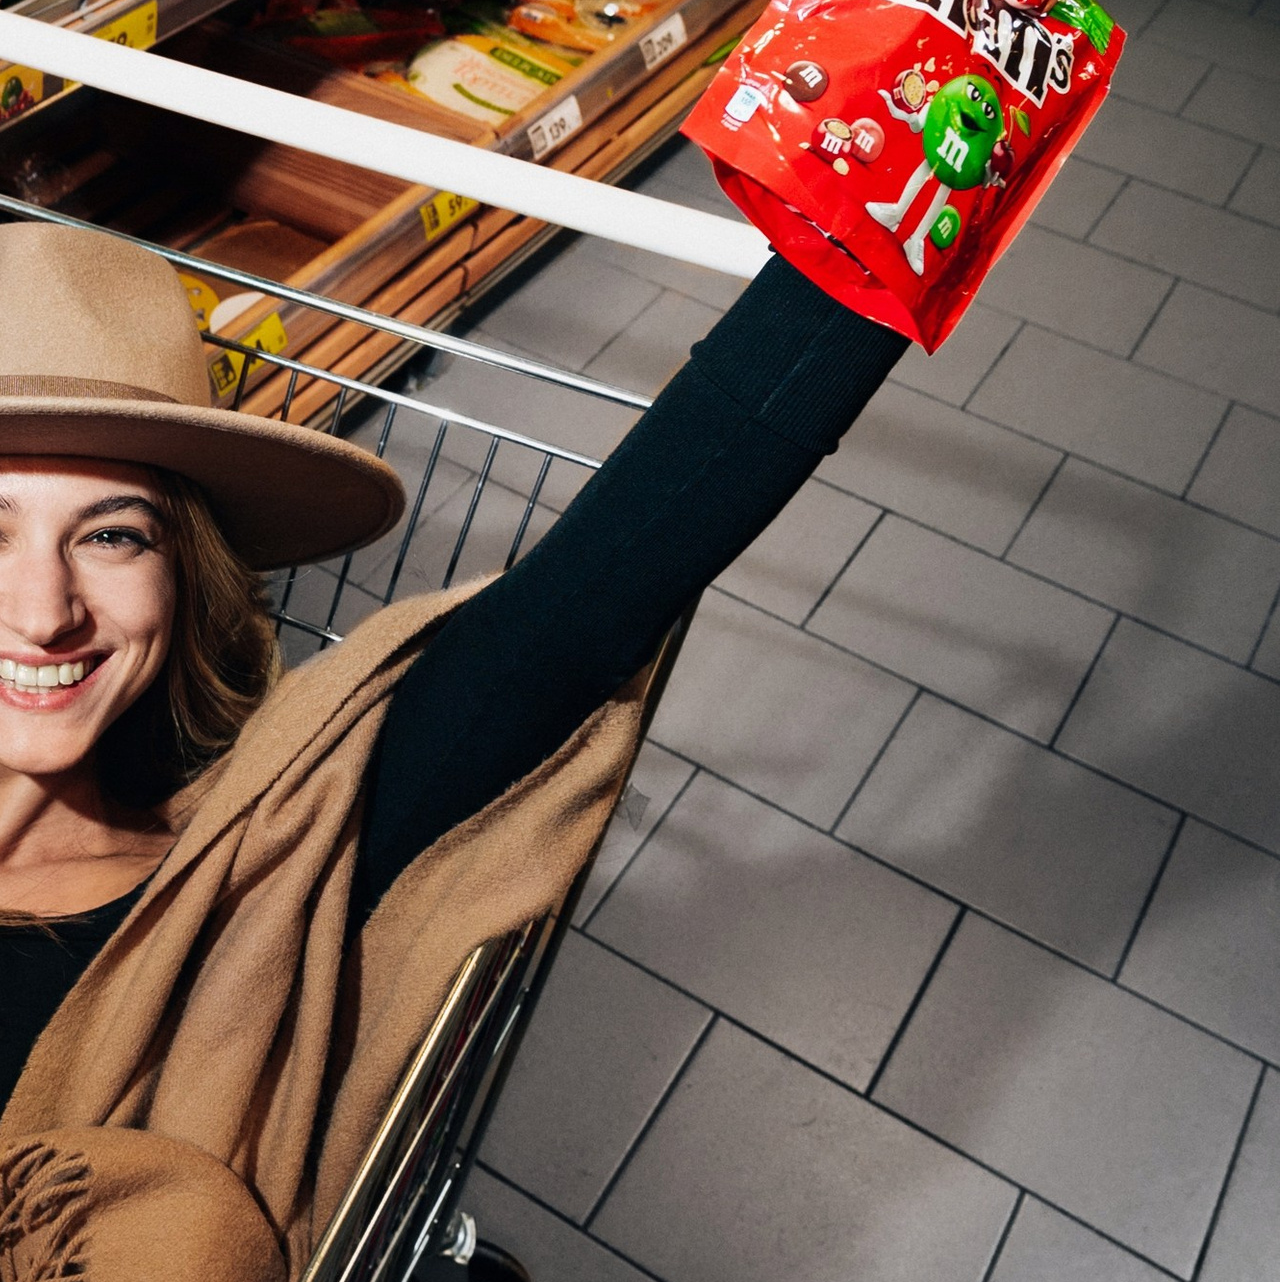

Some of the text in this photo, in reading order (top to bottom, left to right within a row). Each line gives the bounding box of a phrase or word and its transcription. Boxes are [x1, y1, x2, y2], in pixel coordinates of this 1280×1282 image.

[799, 65, 823, 88] m
[820, 132, 843, 155] m
[853, 129, 874, 152] m
[937, 127, 969, 175] m
[938, 216, 952, 240] m
